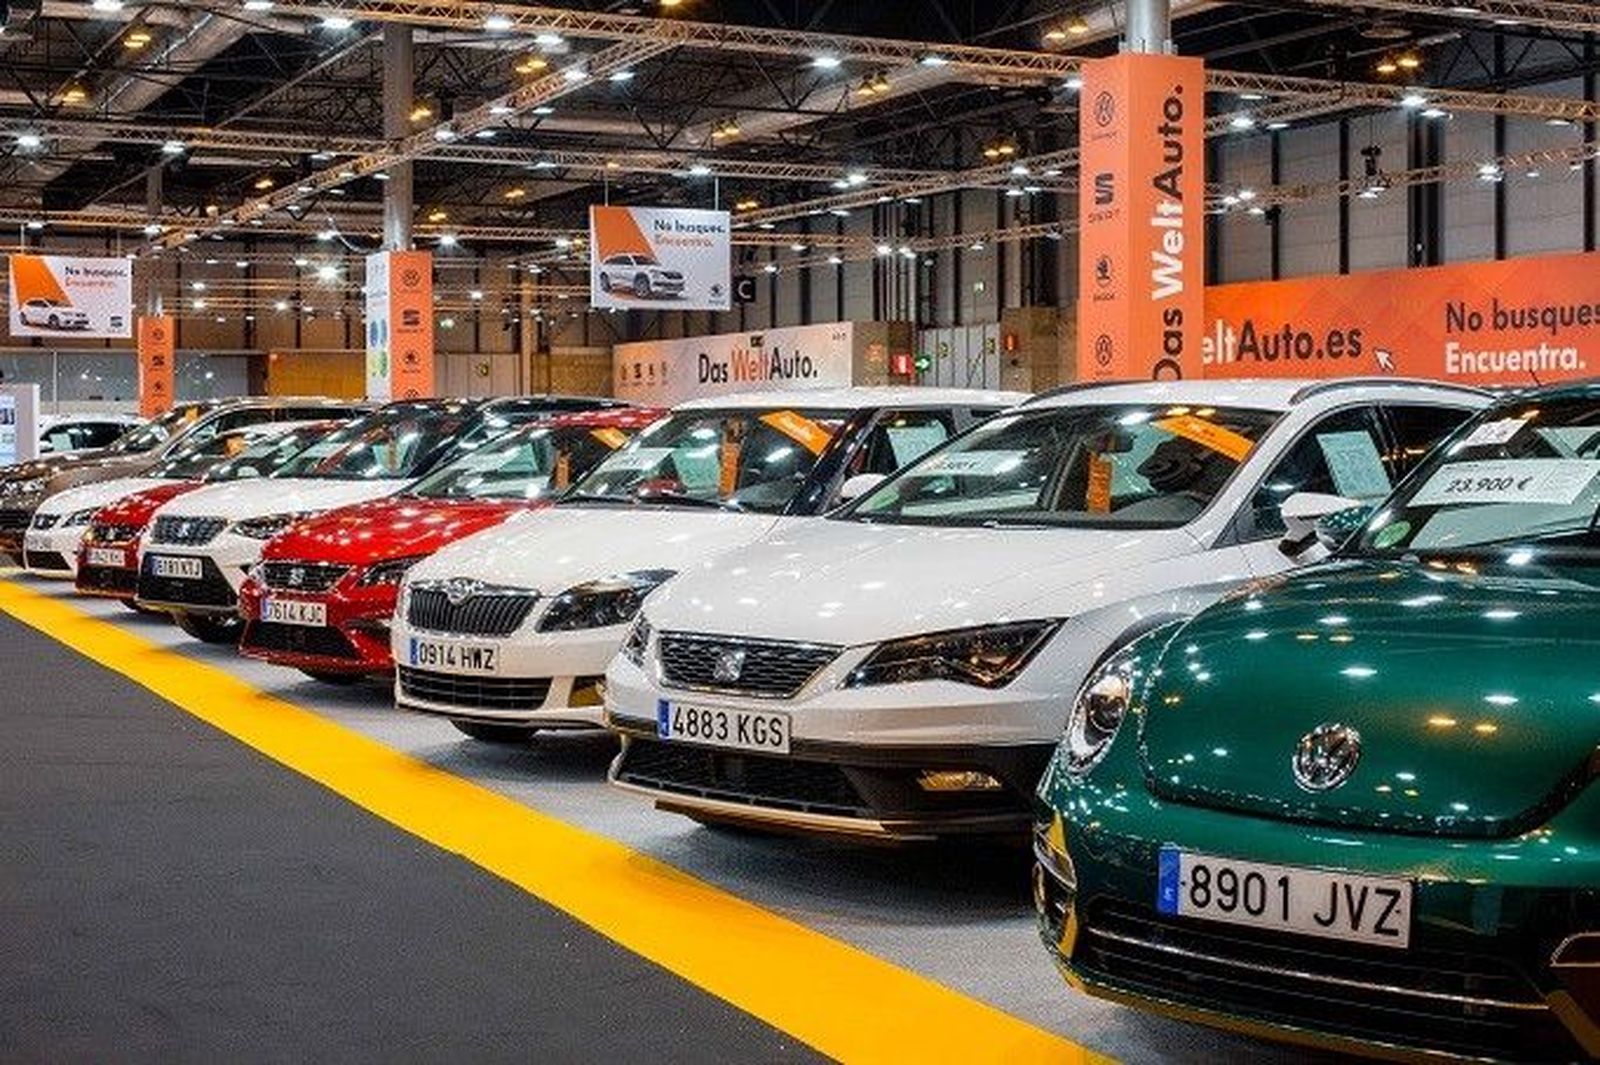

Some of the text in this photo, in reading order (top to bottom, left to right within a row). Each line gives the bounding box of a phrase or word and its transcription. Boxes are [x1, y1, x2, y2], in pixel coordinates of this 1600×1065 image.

[1151, 84, 1185, 301] WeltAuto.
[1446, 298, 1600, 335] No busques
[698, 347, 818, 383] Das WeltAuto.
[1445, 341, 1586, 374] Encuentra.
[419, 642, 494, 670] 0914 HWZ
[673, 706, 782, 747] 4883 KGS
[1190, 865, 1402, 937] 8901 JVZ
